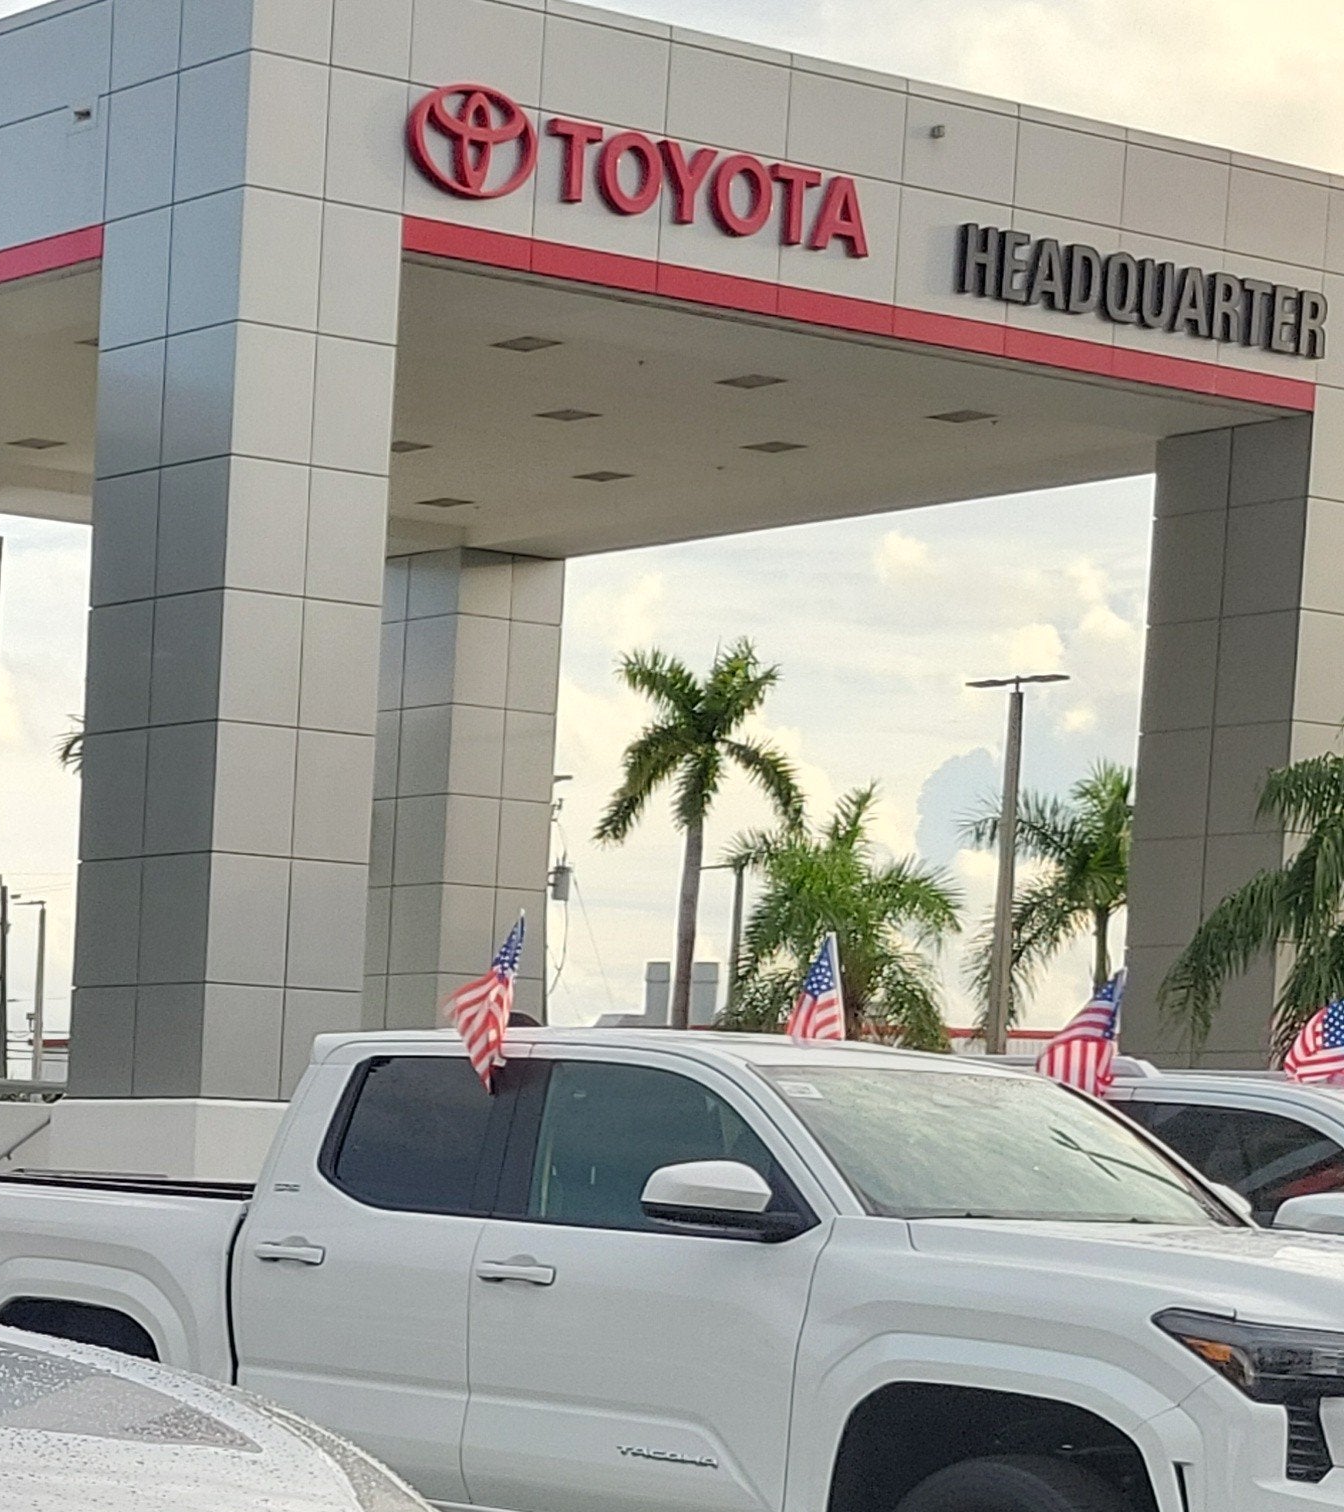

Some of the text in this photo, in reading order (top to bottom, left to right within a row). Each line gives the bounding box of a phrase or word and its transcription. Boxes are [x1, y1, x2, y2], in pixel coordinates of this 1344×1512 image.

[547, 117, 869, 259] TOYOTA
[955, 223, 1328, 359] HEADQUARTER
[616, 1445, 719, 1469] TACOMA
